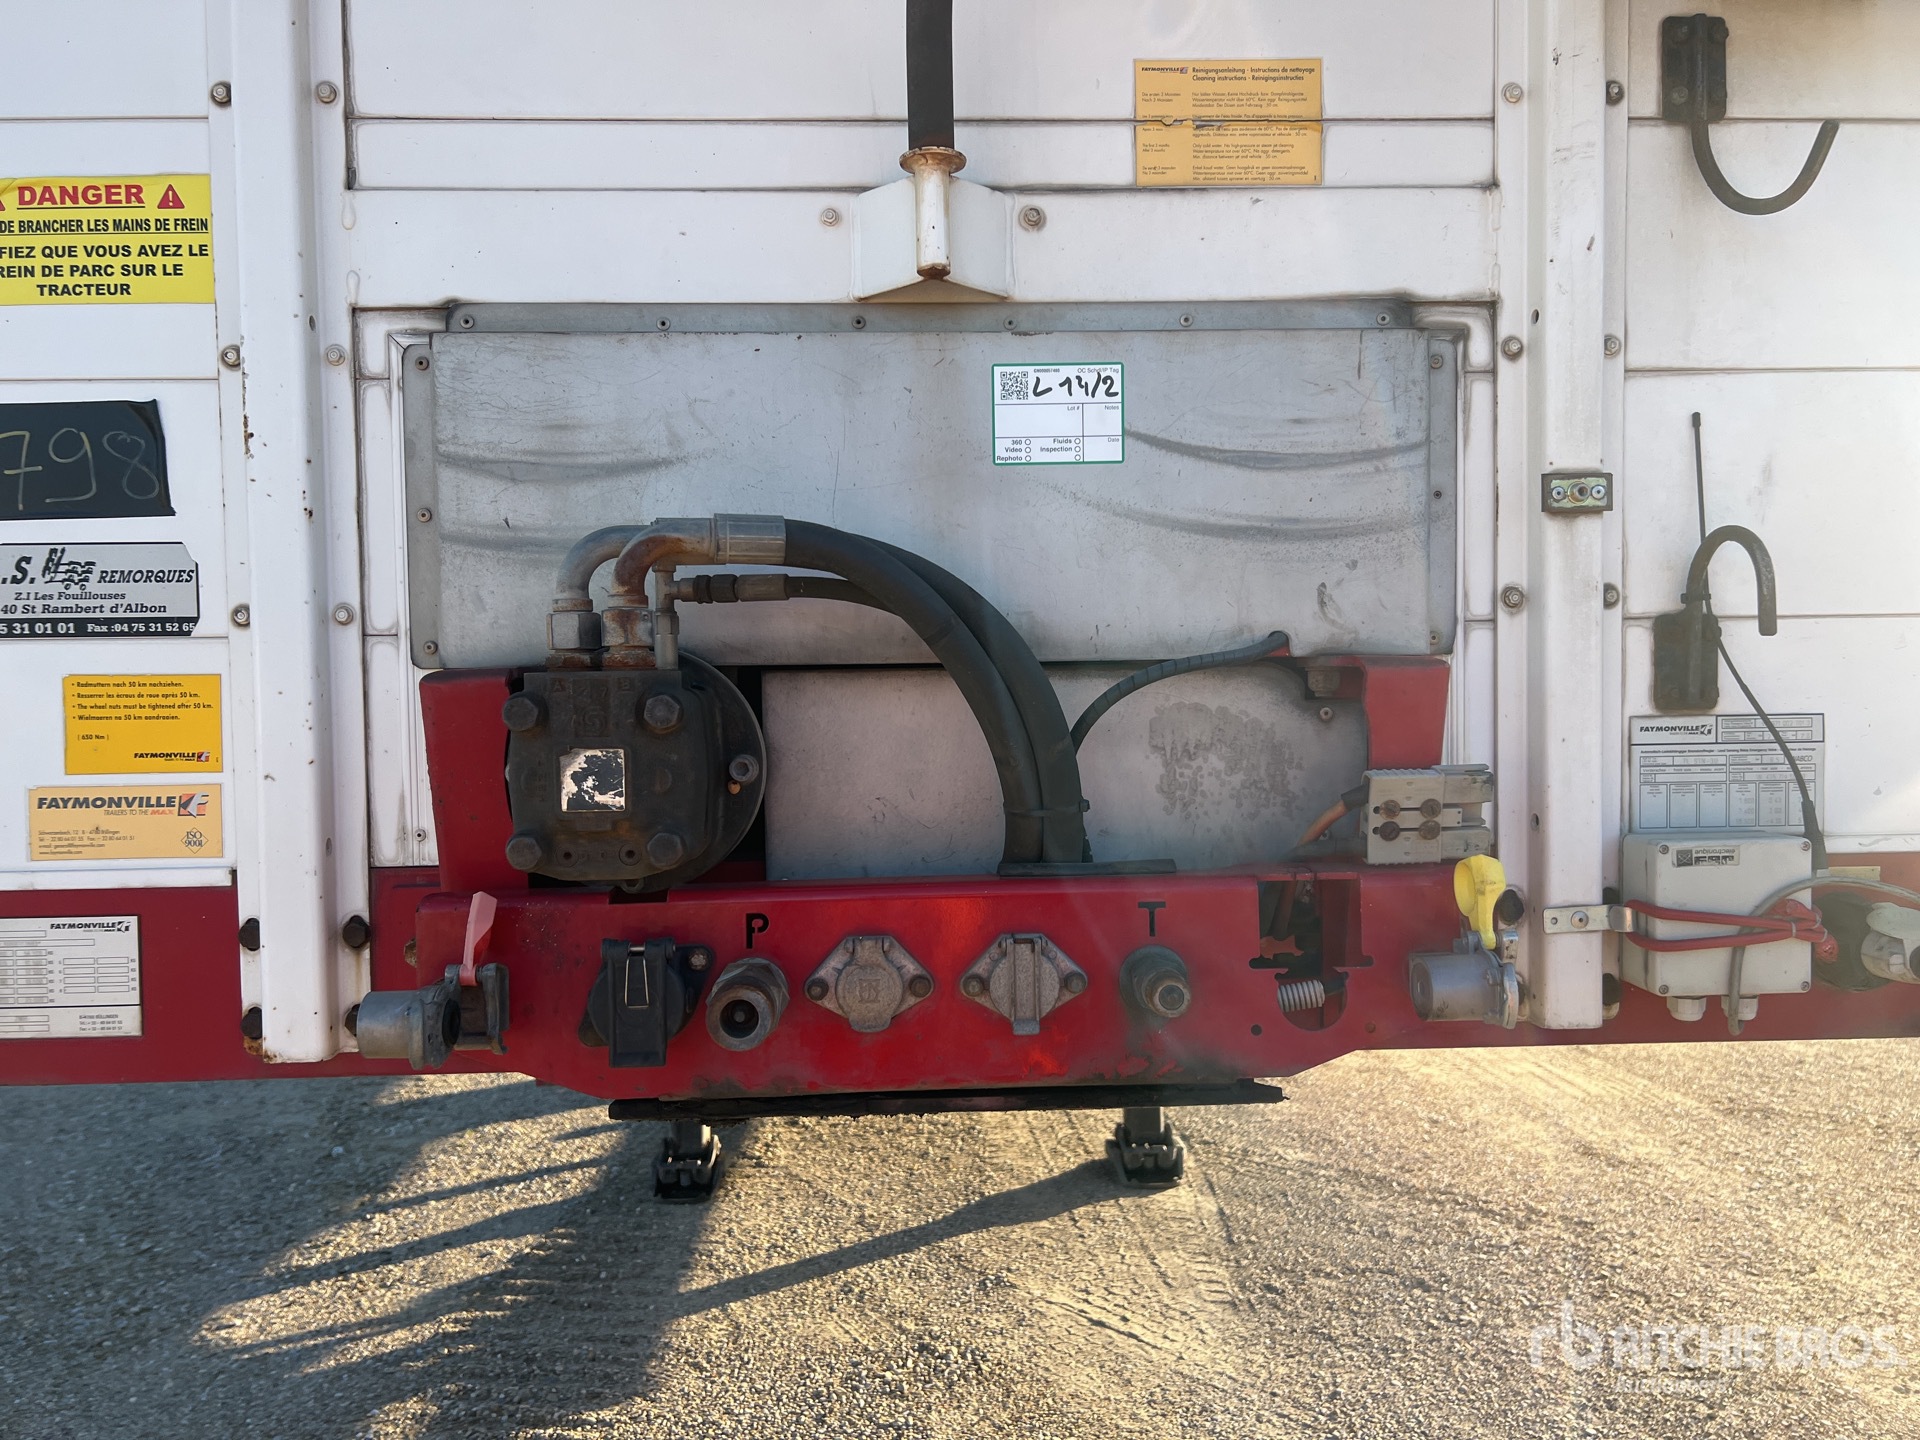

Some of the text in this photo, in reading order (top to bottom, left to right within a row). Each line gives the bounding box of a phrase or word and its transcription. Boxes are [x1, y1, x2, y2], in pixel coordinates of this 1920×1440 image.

[18, 184, 145, 206] DANGER
[0, 218, 208, 233] DE BRANCHER LES MAINS DE FREIN
[41, 246, 78, 259] QUE
[83, 245, 132, 258] VOUS
[137, 244, 183, 257] AVEZ
[188, 244, 208, 256] LE
[42, 265, 64, 277] DE
[70, 264, 115, 277] PARC
[120, 264, 157, 276] SUR
[162, 264, 183, 276] LE
[36, 284, 132, 296] TRACTEUR
[97, 569, 195, 584] REMORQUES
[14, 591, 126, 601] Z.I Les Fouillouses
[21, 604, 36, 614] St
[41, 603, 105, 614] Rambert
[110, 603, 167, 613] d'Albon
[13, 624, 30, 634] 31
[35, 623, 53, 634] 01
[57, 623, 75, 634] 01
[87, 623, 108, 633] Fax
[132, 623, 146, 632] 75
[149, 623, 162, 632] 31
[166, 623, 180, 632] 52
[182, 622, 196, 632] 65
[37, 796, 176, 809] FAYMONVILLE
[186, 831, 202, 839] ISO
[184, 840, 203, 848] 9001
[1138, 901, 1166, 936] T
[745, 913, 769, 948] P
